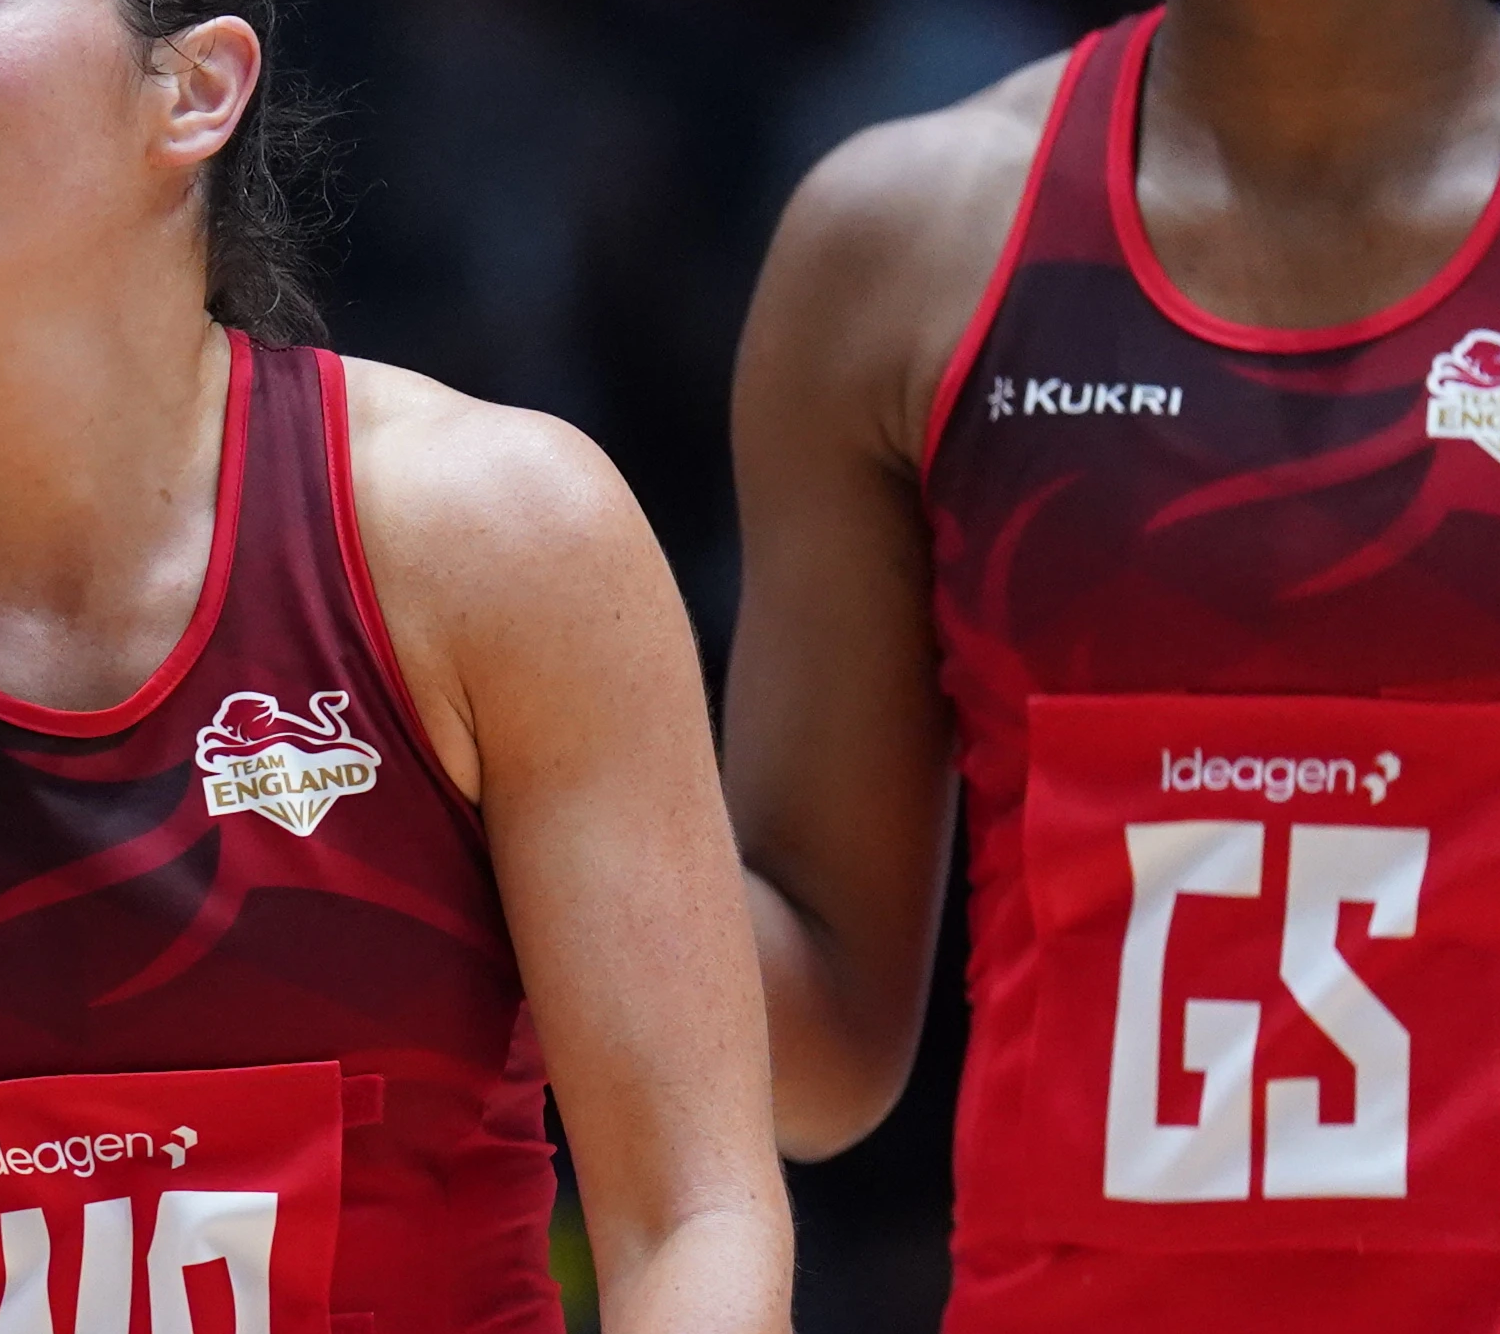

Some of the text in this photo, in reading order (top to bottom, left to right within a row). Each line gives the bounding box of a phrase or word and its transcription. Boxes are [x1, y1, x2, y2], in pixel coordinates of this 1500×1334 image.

[1023, 377, 1184, 416] KUKRI
[211, 762, 370, 808] ENGLAND
[228, 754, 286, 778] TEAM
[1160, 746, 1357, 803] Ideagen
[1103, 821, 1430, 1203] GS
